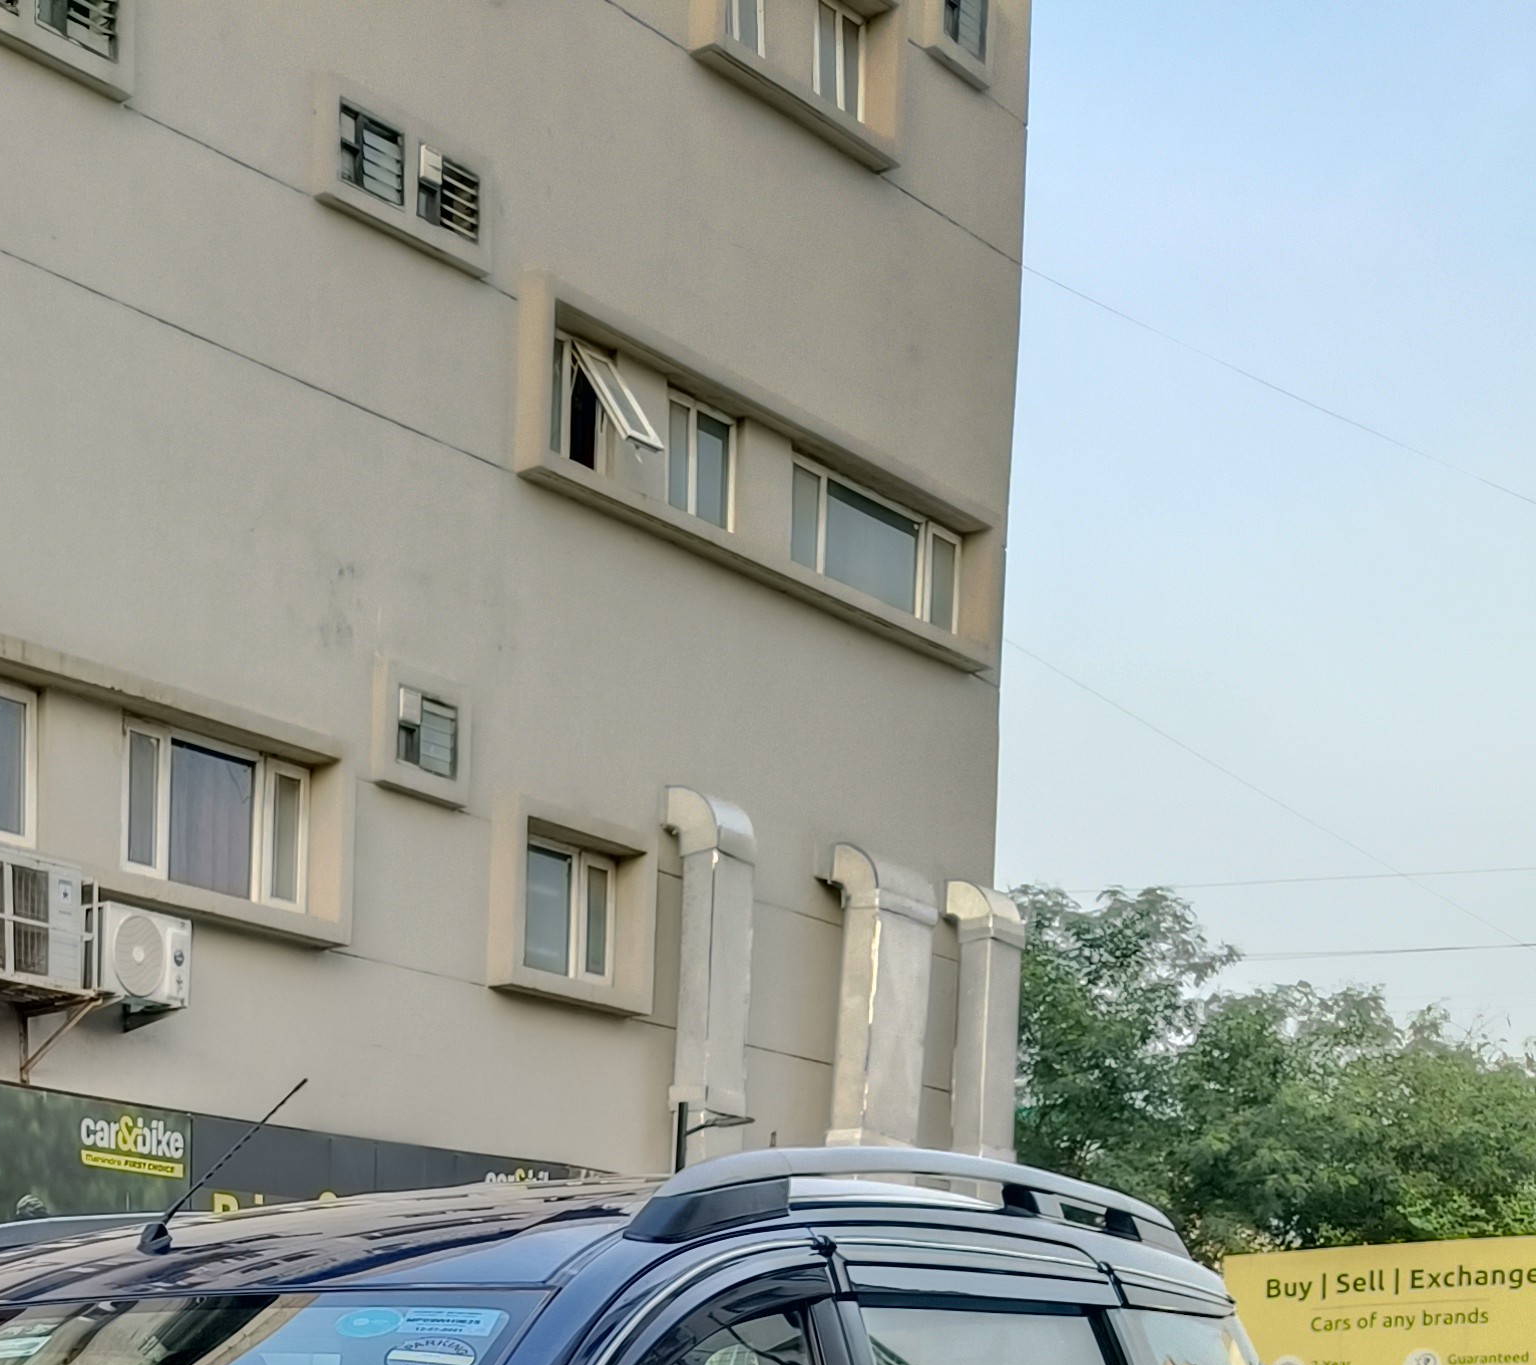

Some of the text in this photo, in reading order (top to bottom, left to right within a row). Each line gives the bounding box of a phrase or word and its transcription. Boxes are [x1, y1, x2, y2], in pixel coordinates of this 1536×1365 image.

[80, 1115, 184, 1159] car&bike
[124, 1159, 147, 1170] FIRST
[1266, 1278, 1313, 1301] Buy
[1336, 1269, 1384, 1294] Sell
[1411, 1265, 1536, 1290] Exchange
[1311, 1307, 1489, 1332] Cars of any brands
[1448, 1351, 1530, 1365] Guaranteed
